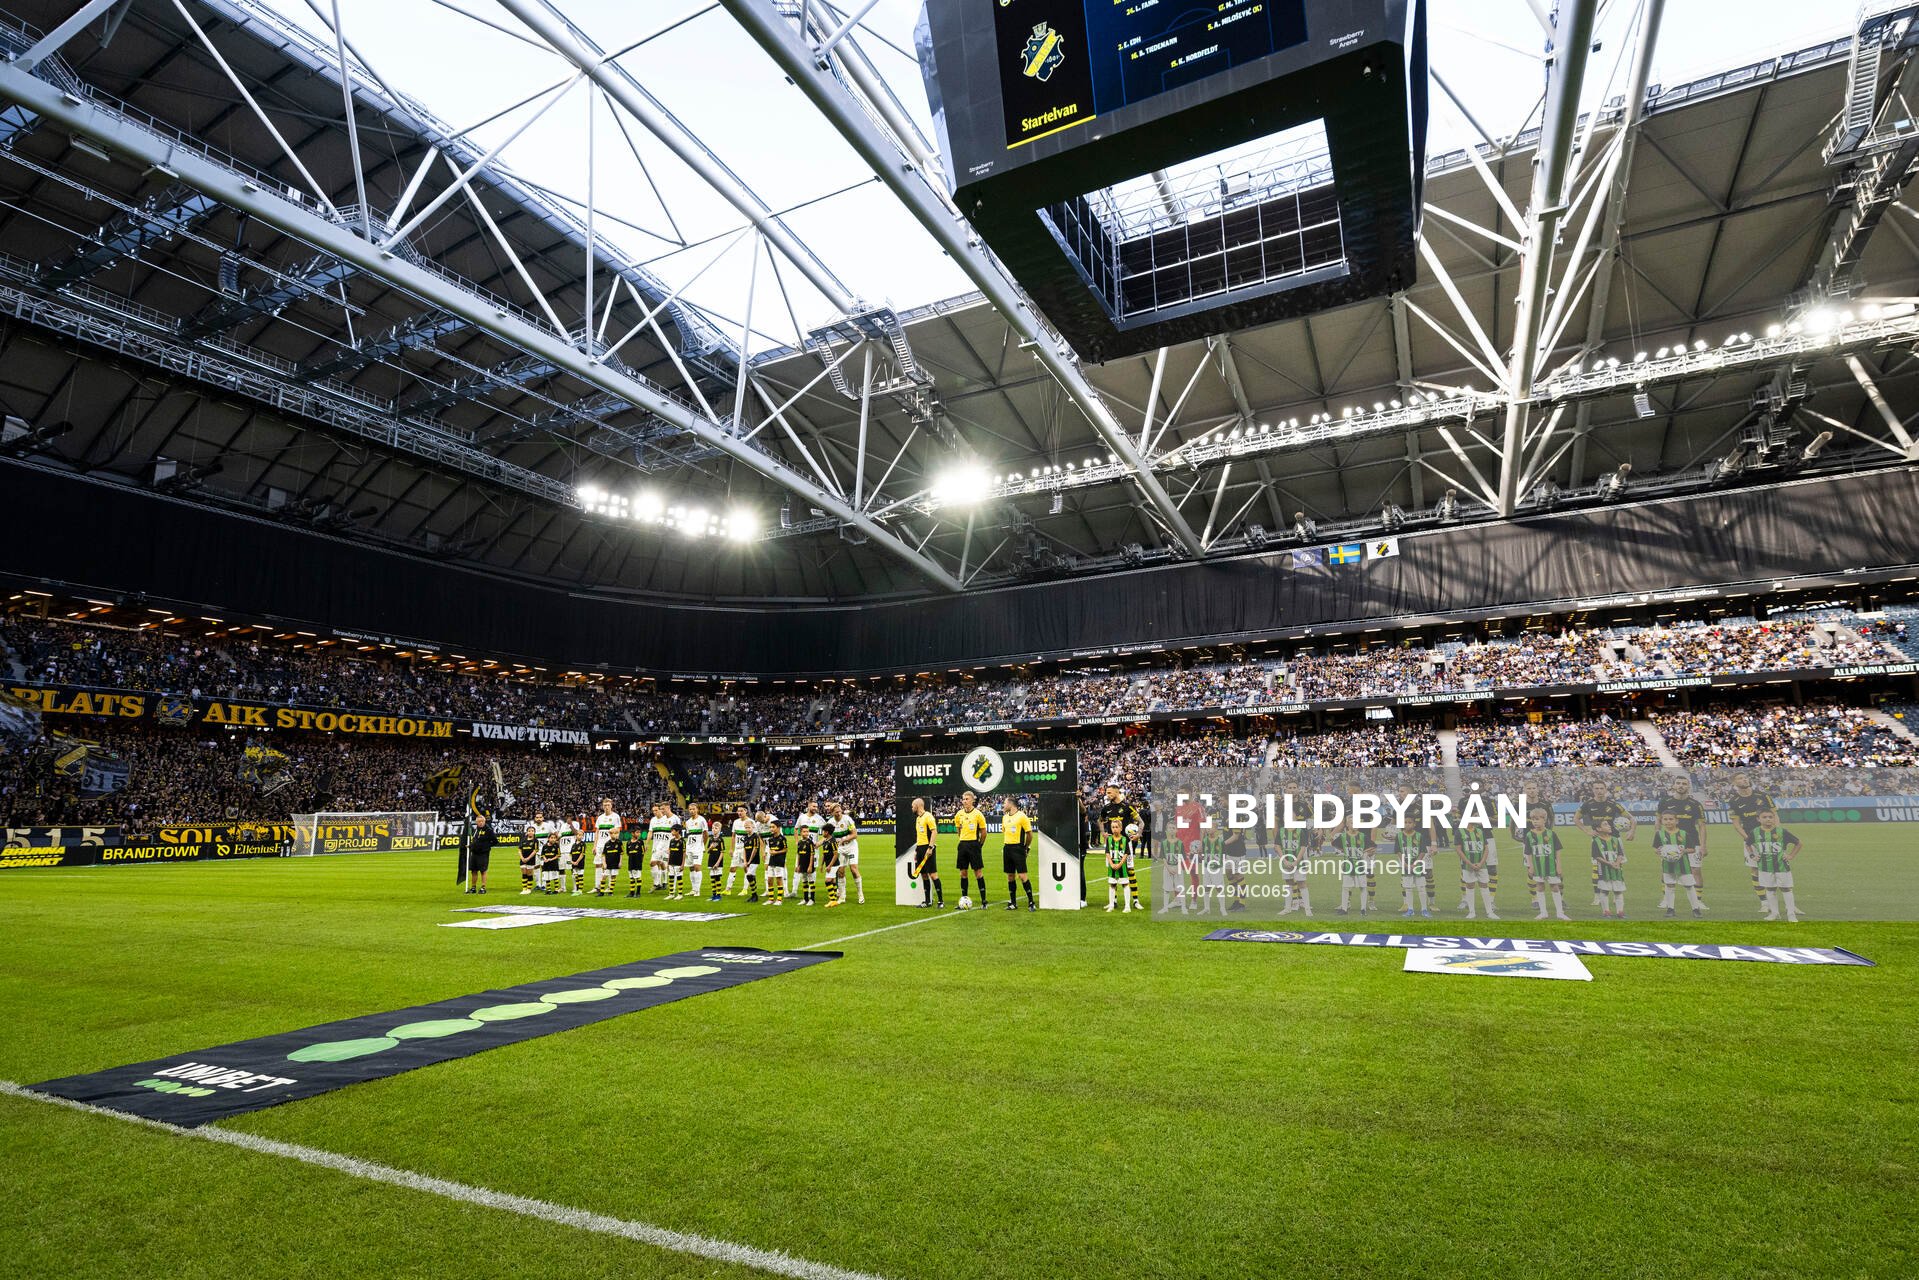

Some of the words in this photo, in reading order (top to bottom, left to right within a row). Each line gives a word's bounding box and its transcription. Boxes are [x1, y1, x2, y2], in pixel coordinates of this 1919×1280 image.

[1329, 29, 1365, 46] Strawberry
[1338, 38, 1358, 49] Arena
[1185, 44, 1219, 62] NORDFELDT
[1022, 103, 1078, 132] Startelvan
[969, 160, 994, 173] Strawberry
[1641, 678, 1712, 689] IDROTTSKLUBBEN
[10, 687, 145, 718] PLATS
[1434, 692, 1494, 702] IDROTTSKLUBBEN
[202, 702, 268, 726] AIK
[276, 708, 454, 738] STOCKHOLM
[472, 723, 518, 740] IVAN
[526, 727, 590, 744] TURINA
[904, 763, 952, 778] UNIBET
[1013, 759, 1067, 774] UNIBET
[338, 838, 378, 848] PROJOB
[102, 846, 201, 860] BRANDTOWN
[1052, 862, 1066, 882] U
[1305, 932, 1838, 964] ALLSVENSKAN
[153, 1062, 298, 1093] UNIBET
